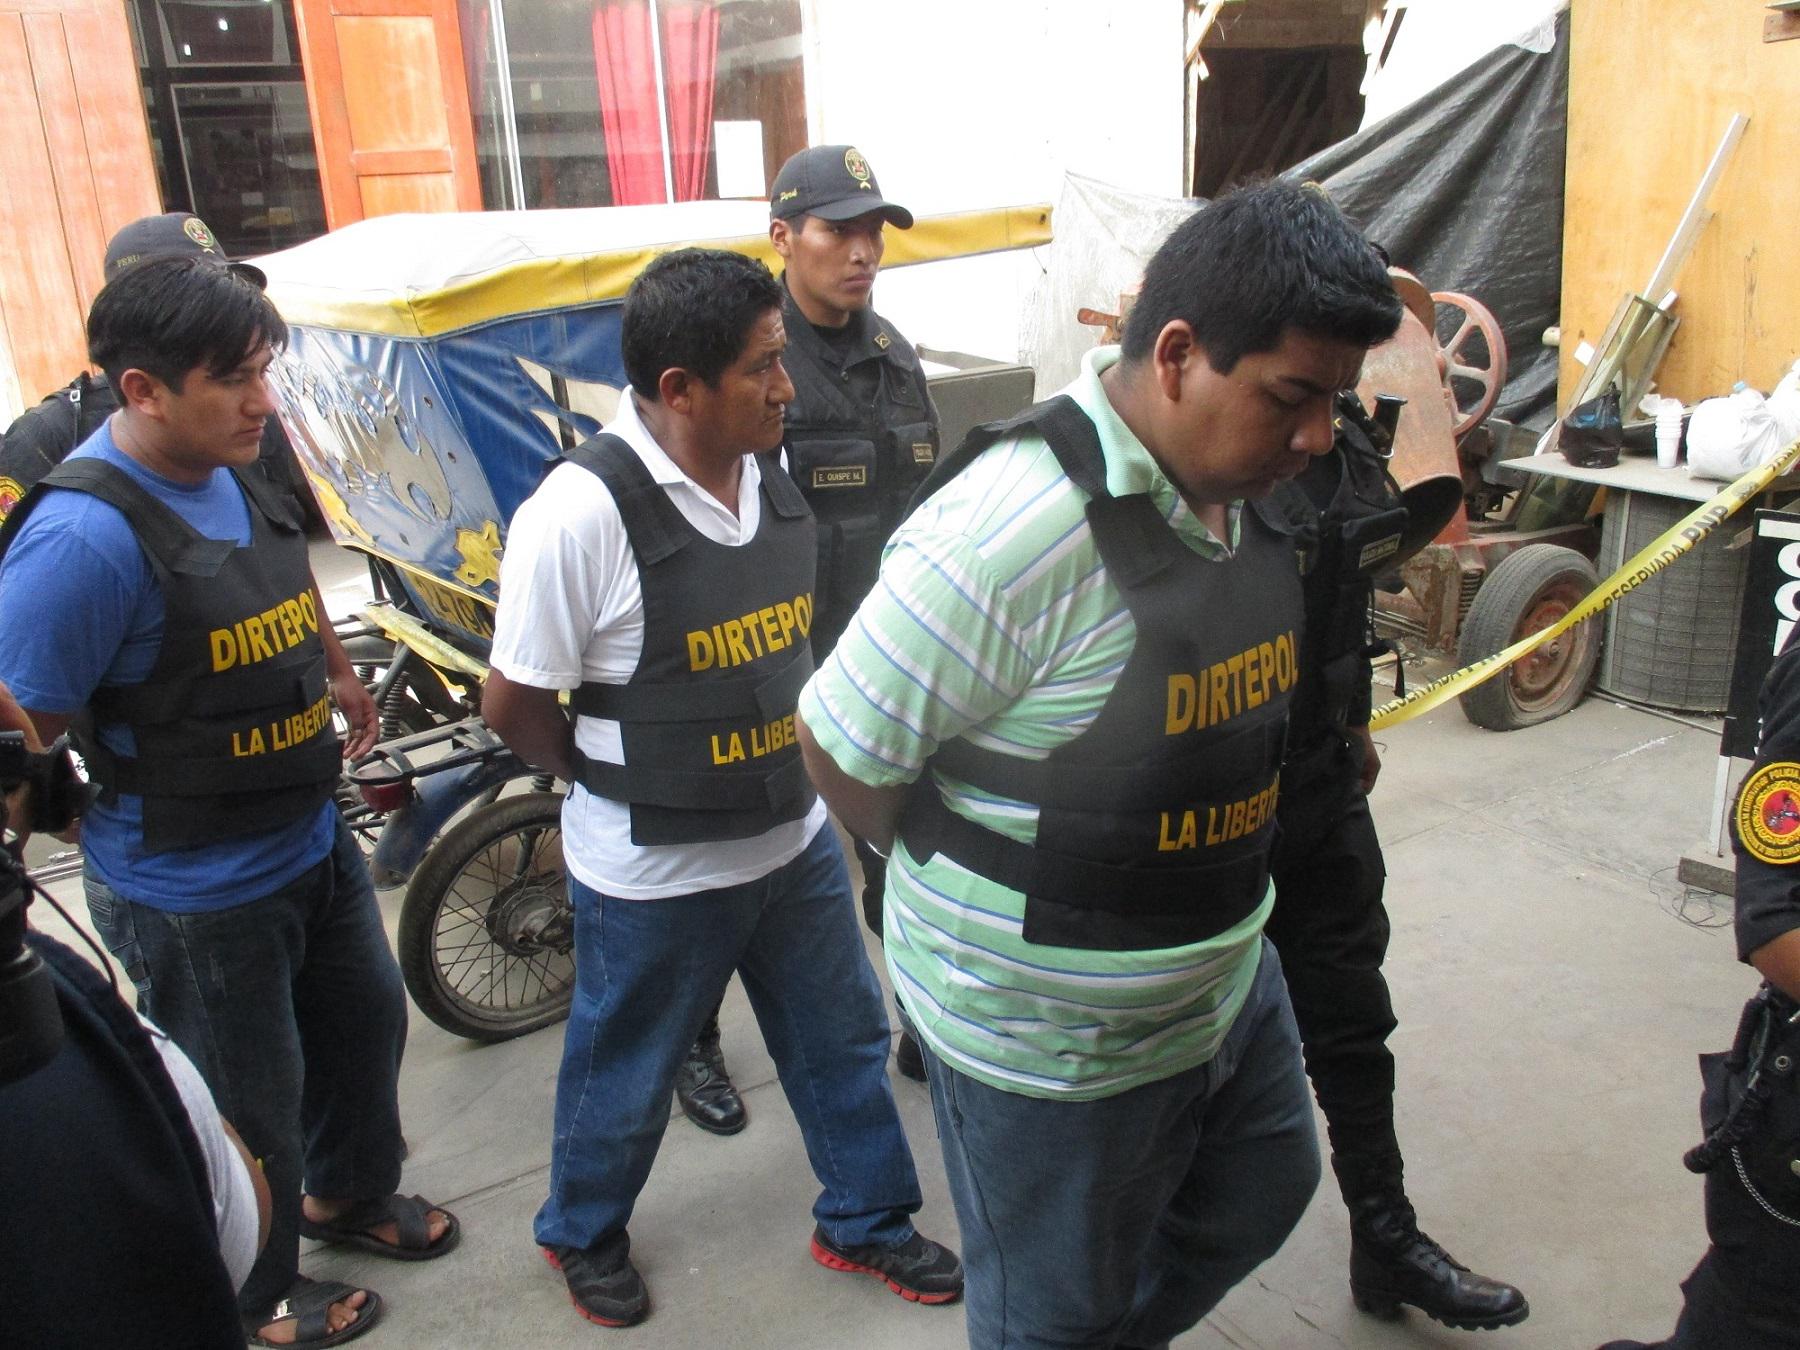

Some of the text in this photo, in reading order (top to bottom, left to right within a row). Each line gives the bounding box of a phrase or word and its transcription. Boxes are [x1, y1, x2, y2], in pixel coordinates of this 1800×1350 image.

[1165, 630, 1298, 735] DIRTEPOL
[232, 727, 267, 757] LA
[711, 714, 800, 765] LA LIBE
[1157, 810, 1197, 851] LA
